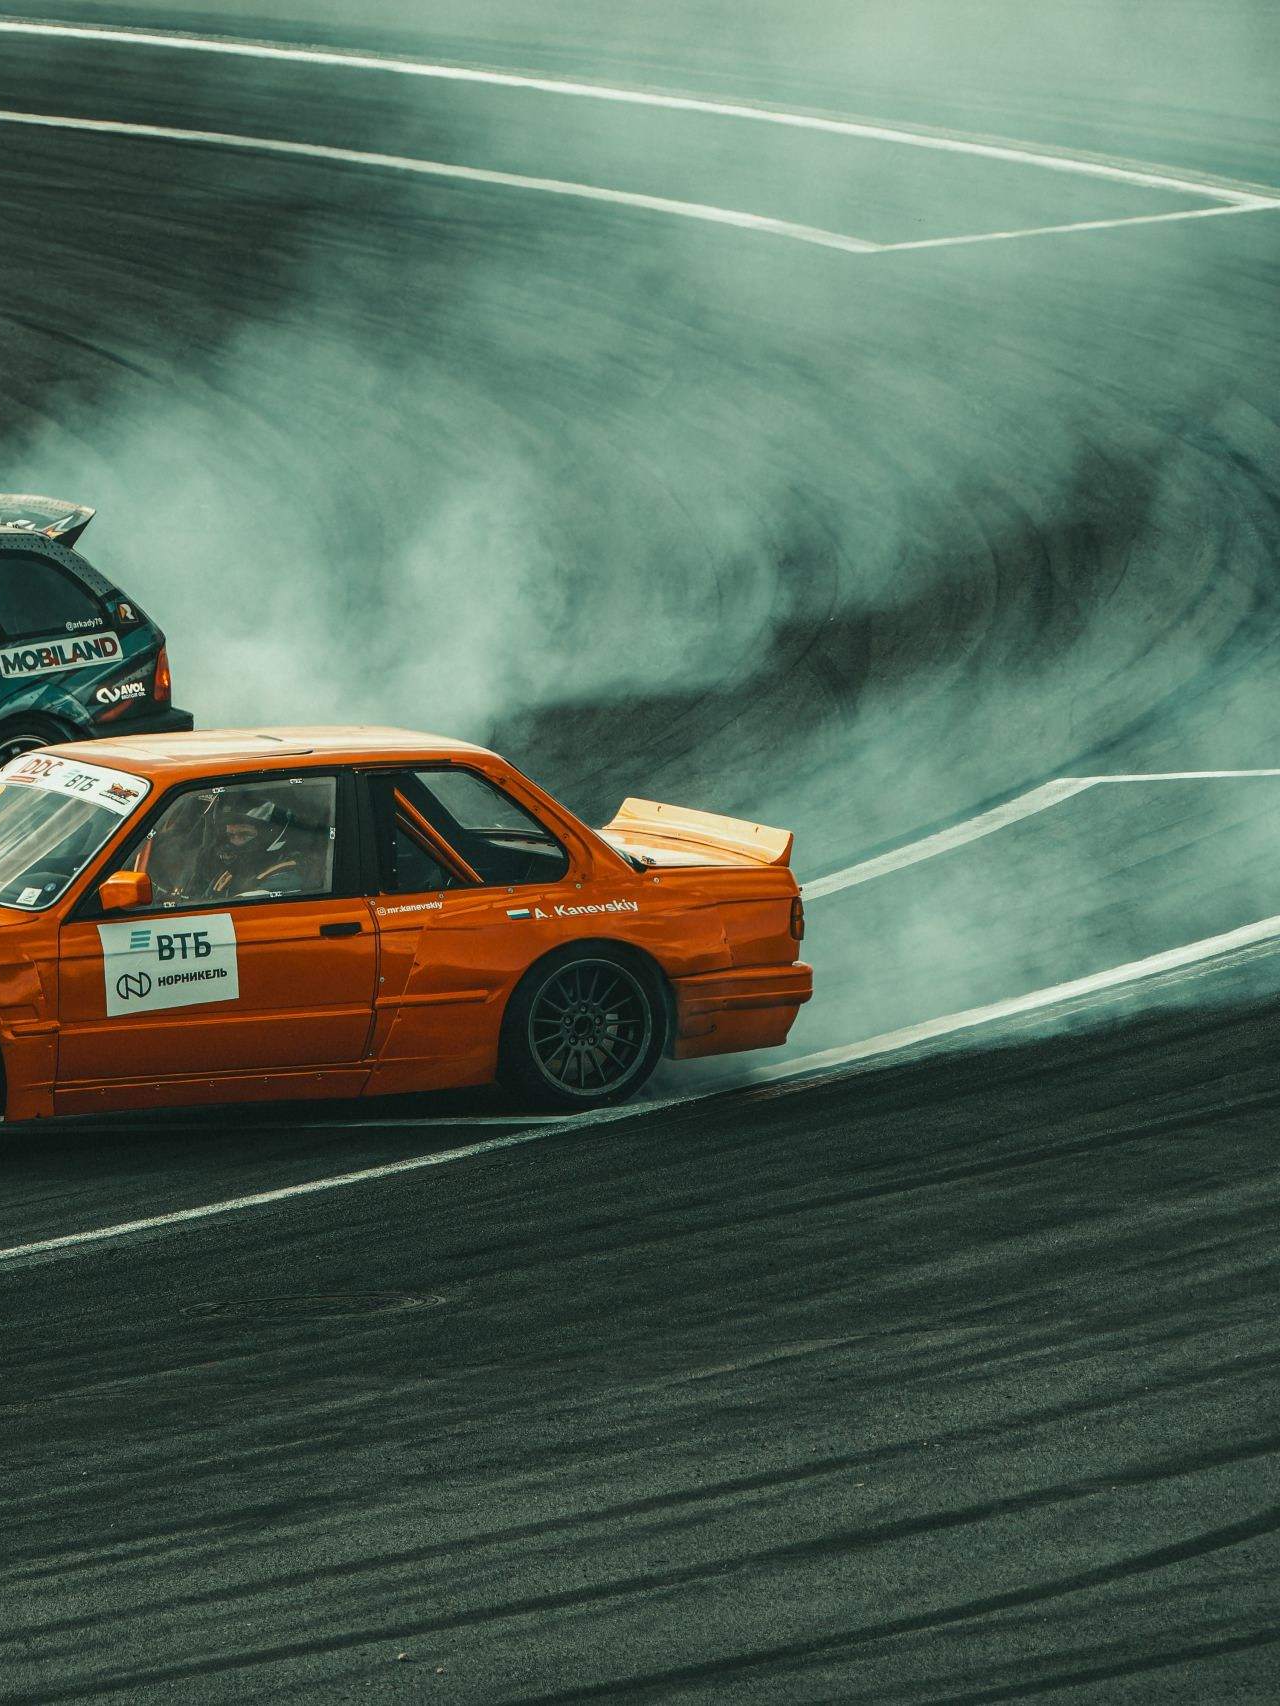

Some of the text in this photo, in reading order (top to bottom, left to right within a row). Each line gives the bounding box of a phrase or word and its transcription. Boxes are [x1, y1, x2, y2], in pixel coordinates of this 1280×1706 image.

[1, 637, 118, 675] MOBILAND
[121, 682, 146, 695] AVOL
[64, 774, 100, 792] ВТБ
[387, 901, 443, 914] mr.kanevskiy
[534, 899, 639, 919] A. Kanevskiy
[157, 931, 212, 961] ВТБ
[158, 967, 228, 987] НОРНИКЕЛЬ
